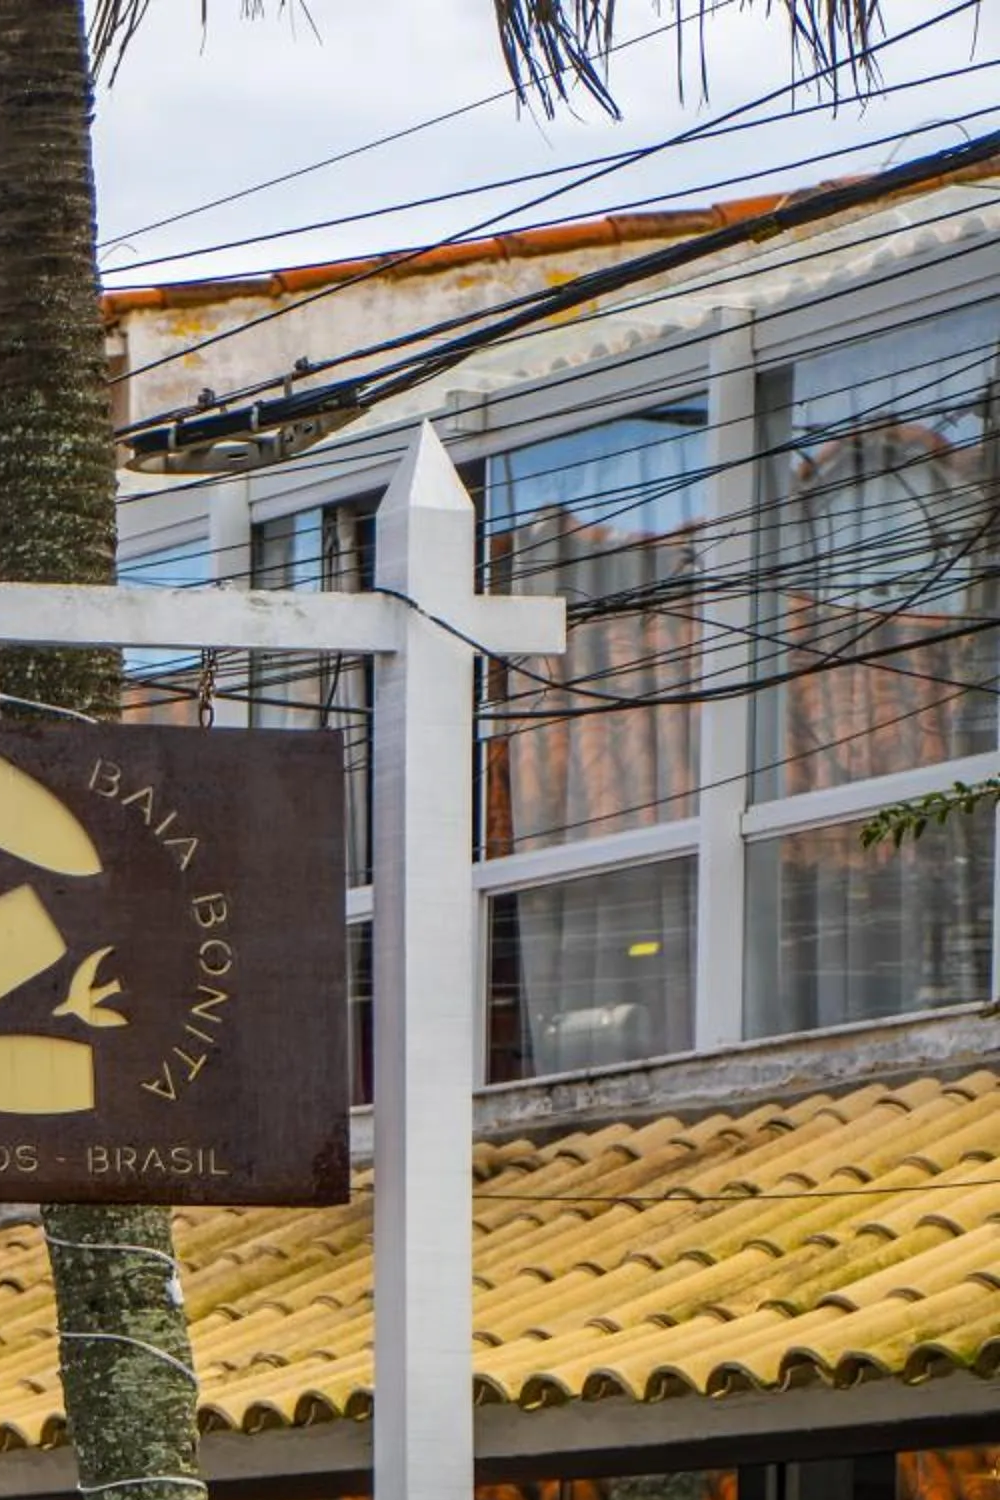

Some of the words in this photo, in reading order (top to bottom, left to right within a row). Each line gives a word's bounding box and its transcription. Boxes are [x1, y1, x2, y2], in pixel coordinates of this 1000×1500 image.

[88, 757, 201, 872] BAIA
[140, 892, 233, 1102] BONITA
[87, 1145, 230, 1177] BRASIL
